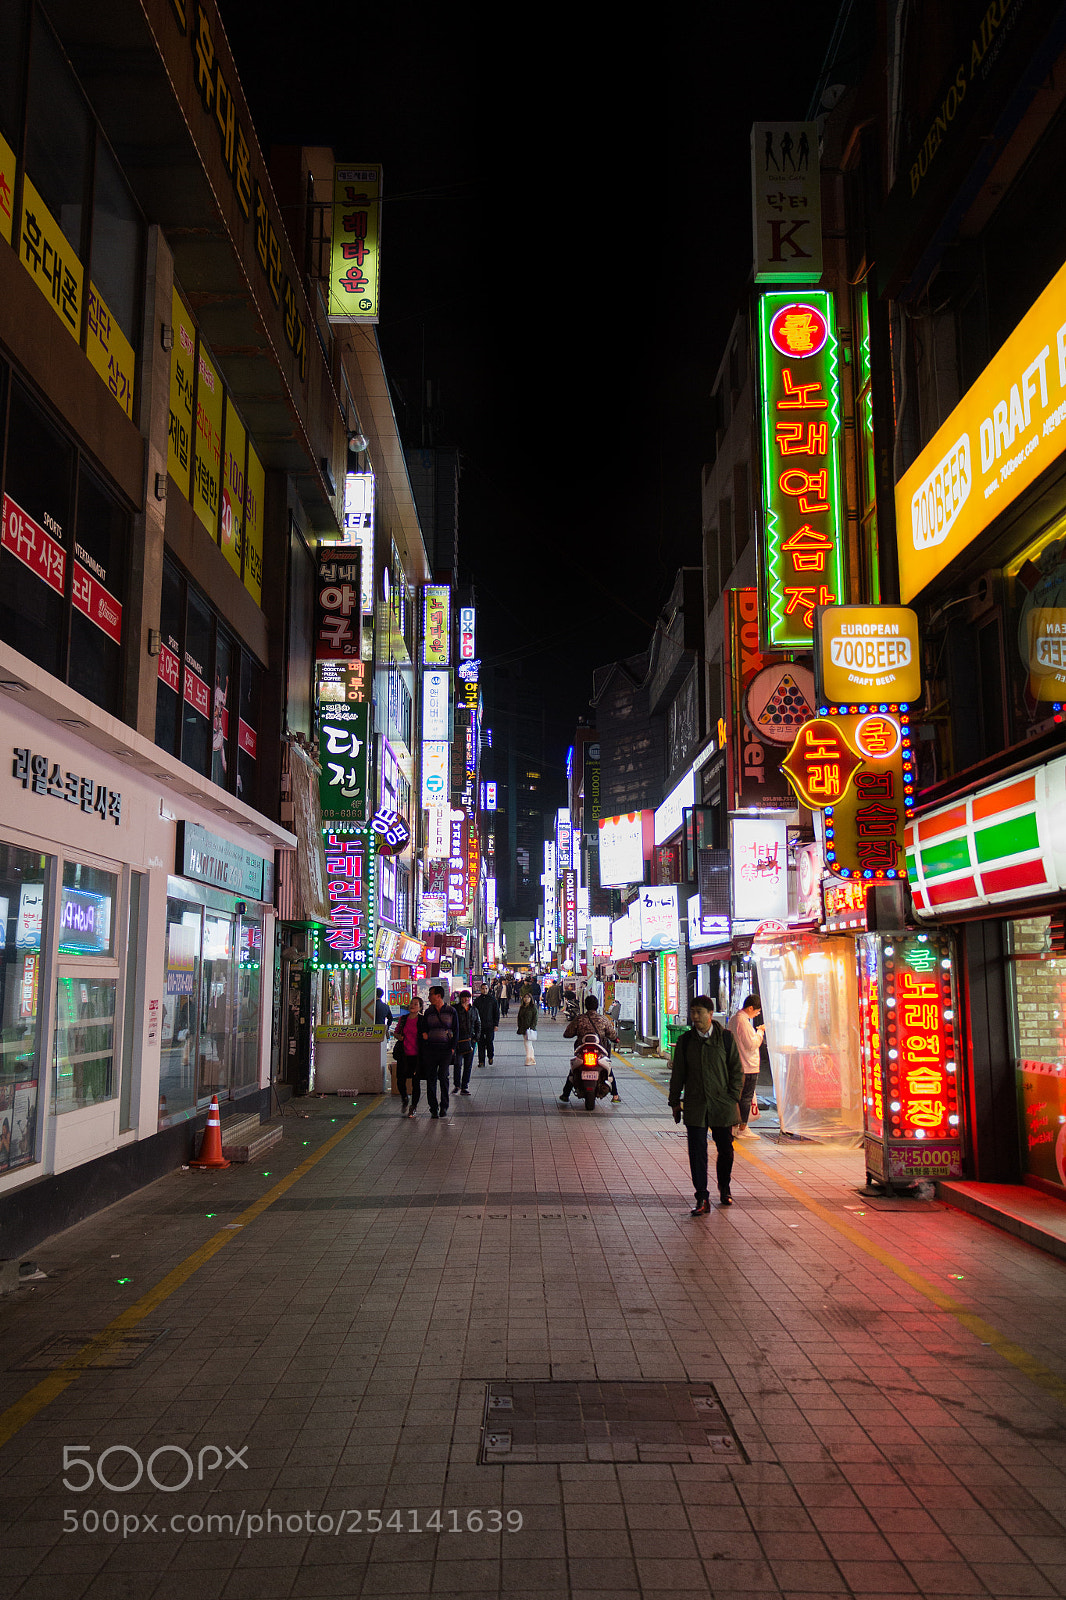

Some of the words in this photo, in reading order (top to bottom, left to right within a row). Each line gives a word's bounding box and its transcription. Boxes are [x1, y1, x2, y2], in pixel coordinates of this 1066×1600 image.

[191, 3, 251, 223] 휴대폰
[909, 63, 967, 199] BUENOS
[766, 192, 807, 212] 닥터
[767, 220, 813, 262] K
[22, 208, 78, 329] 휴대폰
[88, 288, 110, 353] 집단
[107, 355, 131, 413] 상가
[360, 300, 371, 310] 5F
[176, 359, 193, 415] 부산
[980, 345, 1049, 474] DRAFT
[168, 409, 187, 472] 제일
[912, 436, 969, 542] 700BEER
[44, 511, 63, 539] SPORTS
[9, 511, 36, 560] 야구
[40, 540, 64, 588] 사격
[320, 564, 356, 582] 실내
[319, 584, 357, 649] 야구
[841, 624, 899, 635] EUROPEAN
[343, 644, 357, 654] 2F
[833, 640, 908, 669] 700BEER
[166, 655, 179, 687] 야구
[848, 673, 874, 687] DRAFT
[875, 673, 896, 686] BEER
[769, 725, 792, 735] 솔리드
[862, 721, 891, 752] 쿨
[322, 725, 364, 798] 다전
[804, 728, 841, 797] 노래
[12, 748, 121, 825] 리얼스크린사격
[591, 767, 600, 797] Room
[854, 771, 902, 870] 연습장
[190, 848, 228, 882] HUNTING
[324, 834, 367, 950] 노래연습장
[566, 872, 575, 901] HOLLYS
[566, 909, 575, 939] COFFEE
[342, 950, 367, 962] 지하
[390, 993, 410, 1006] 600
[391, 981, 407, 992] 10분
[902, 973, 946, 1128] 노래연습장
